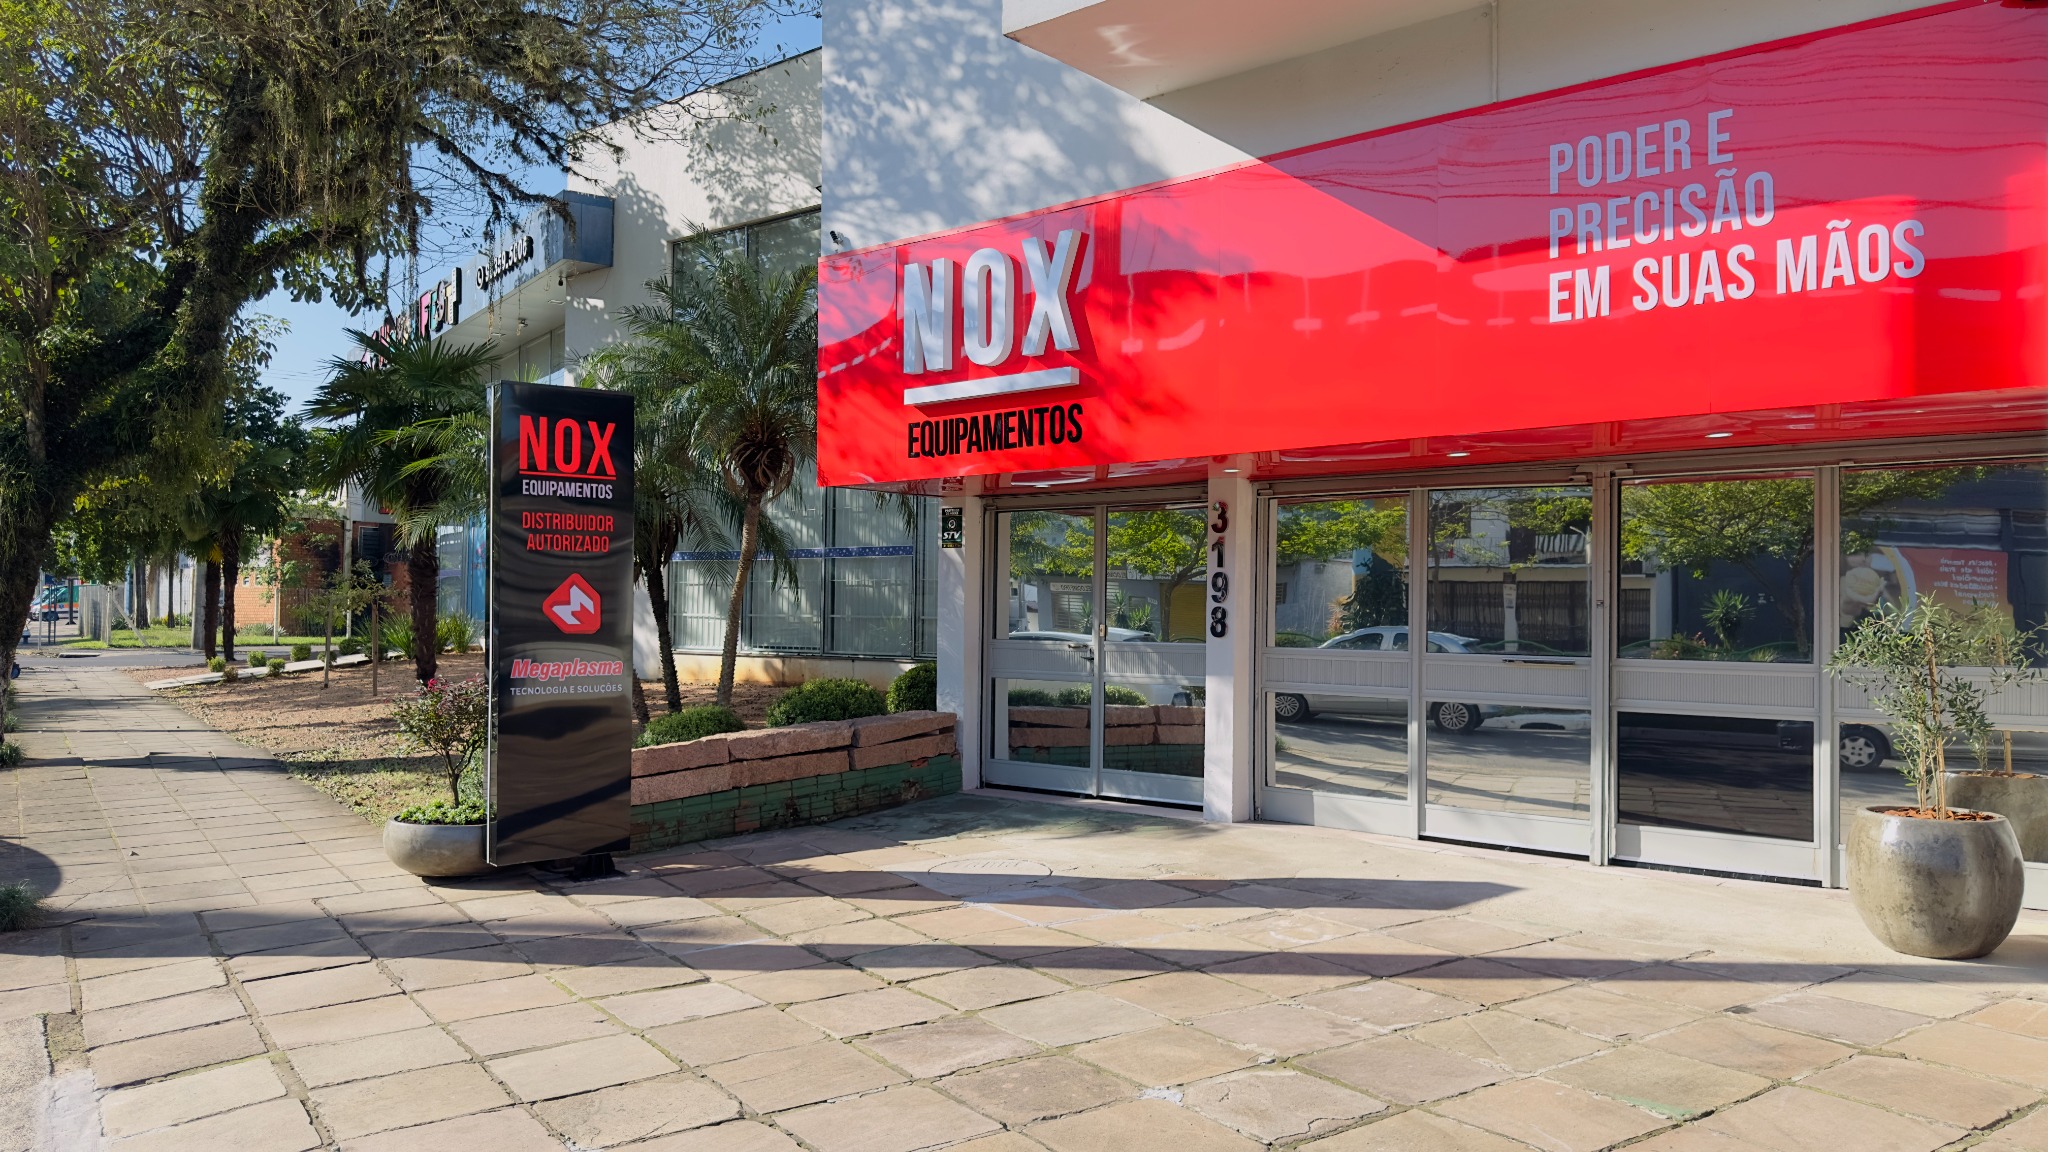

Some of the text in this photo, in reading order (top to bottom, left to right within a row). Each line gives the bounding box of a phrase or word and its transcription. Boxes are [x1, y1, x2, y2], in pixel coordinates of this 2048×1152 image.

[1549, 108, 1734, 195] PODER E
[1549, 167, 1775, 259] PRECISÃO
[1549, 218, 1926, 323] EM SUAS MÃOS
[903, 229, 1080, 375] NOX
[519, 414, 616, 476] NOX
[907, 403, 1084, 459] EQUIPAMENTOS
[522, 479, 613, 500] EQUIPAMENTOS
[522, 511, 614, 532] DISTRIBUIDOR
[526, 533, 610, 553] AUTORIZADO
[942, 530, 962, 540] STV
[1210, 501, 1230, 638] 3198
[510, 658, 623, 681] Megaplasma
[510, 682, 623, 696] TECNOLOGIA E SOLUÇÕES
